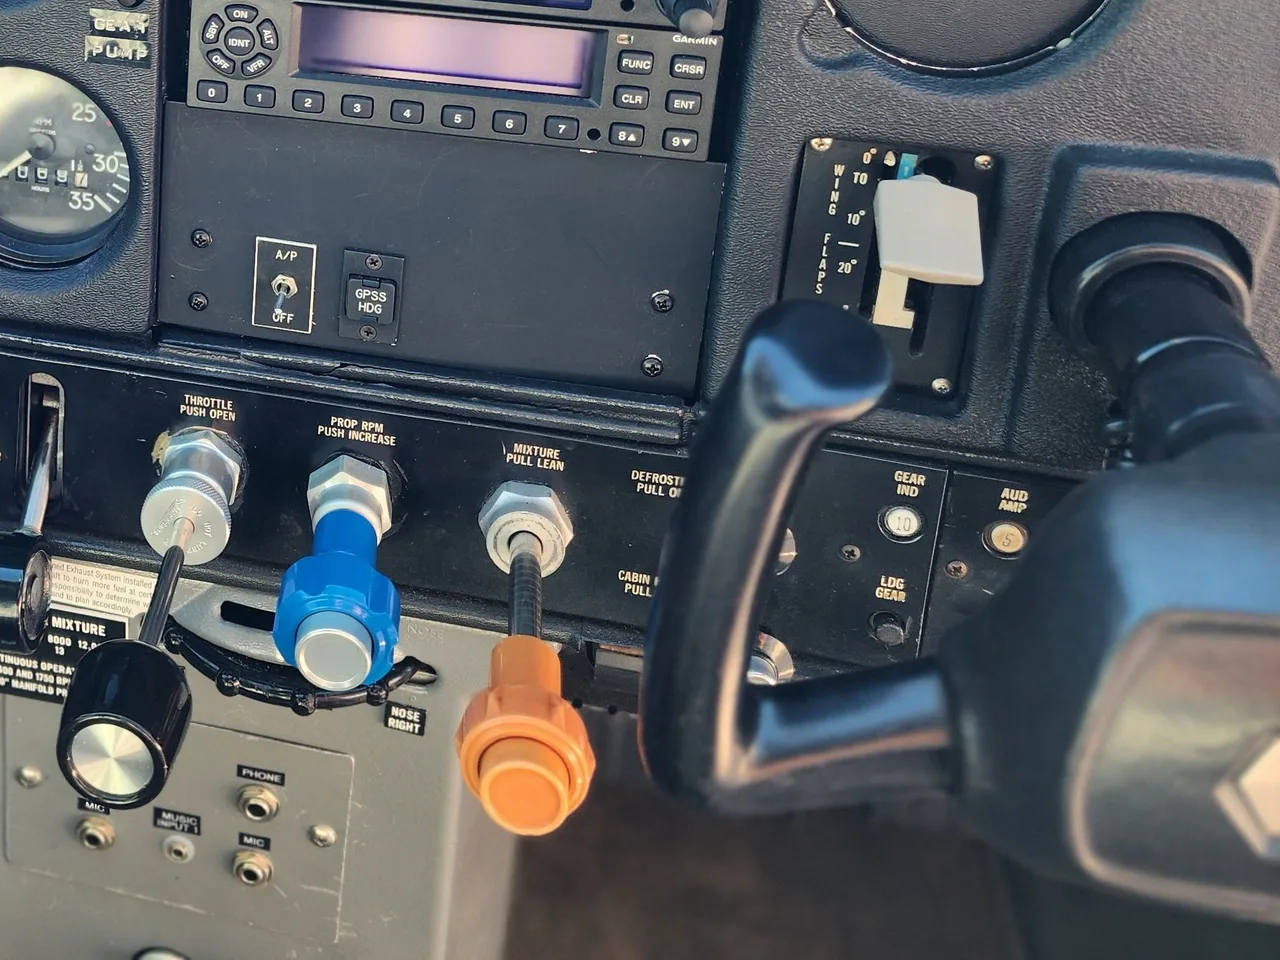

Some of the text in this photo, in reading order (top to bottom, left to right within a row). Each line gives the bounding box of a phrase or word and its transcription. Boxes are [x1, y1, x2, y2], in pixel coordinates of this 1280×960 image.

[233, 10, 248, 19] ON
[93, 18, 146, 34] GEAR
[206, 22, 218, 39] SBY
[228, 38, 251, 48] IDNT
[263, 29, 273, 45] ALT
[92, 45, 148, 61] PUMP
[212, 56, 230, 71] OFF
[247, 59, 265, 73] VFR
[622, 59, 651, 69] FUNC
[675, 63, 704, 74] CRSR
[622, 94, 642, 104] CLR
[674, 99, 695, 110] ENT
[72, 103, 97, 122] 25
[93, 154, 119, 173] 30
[69, 192, 95, 211] 35
[275, 250, 298, 262] A/P
[815, 233, 831, 294] FLAPS
[355, 289, 387, 303] GPSS
[358, 302, 382, 315] HDG
[272, 312, 294, 325] OFF
[184, 394, 234, 411] THROTTLE
[180, 405, 236, 422] PUSH OPEN
[331, 416, 384, 433] PROP RPM
[318, 425, 397, 447] PUSH INCREASE
[513, 443, 561, 460] MIXTURE
[506, 453, 565, 472] PULL LEAN
[894, 470, 926, 487] GEAR
[636, 482, 665, 497] PULL
[897, 484, 919, 498] IND
[1000, 487, 1029, 502] AUD
[998, 499, 1028, 514] AMP
[895, 516, 912, 532] 10
[66, 564, 94, 577] Exhaust
[95, 570, 122, 584] System
[618, 570, 651, 585] CABIN
[73, 576, 90, 586] burn
[92, 580, 110, 591] more
[113, 583, 127, 593] fuel
[880, 575, 905, 590] LDG
[875, 586, 907, 603] GEAR
[51, 616, 106, 637] MIXTURE
[47, 635, 72, 647] 8000
[16, 668, 33, 680] AND
[35, 672, 54, 684] 1750
[11, 679, 54, 695] MANIFOLD
[391, 707, 420, 722] NOSE
[388, 718, 421, 734] RIGHT
[242, 768, 282, 782] PHONE
[162, 812, 197, 826] MUSIC
[243, 836, 265, 848] MIC
